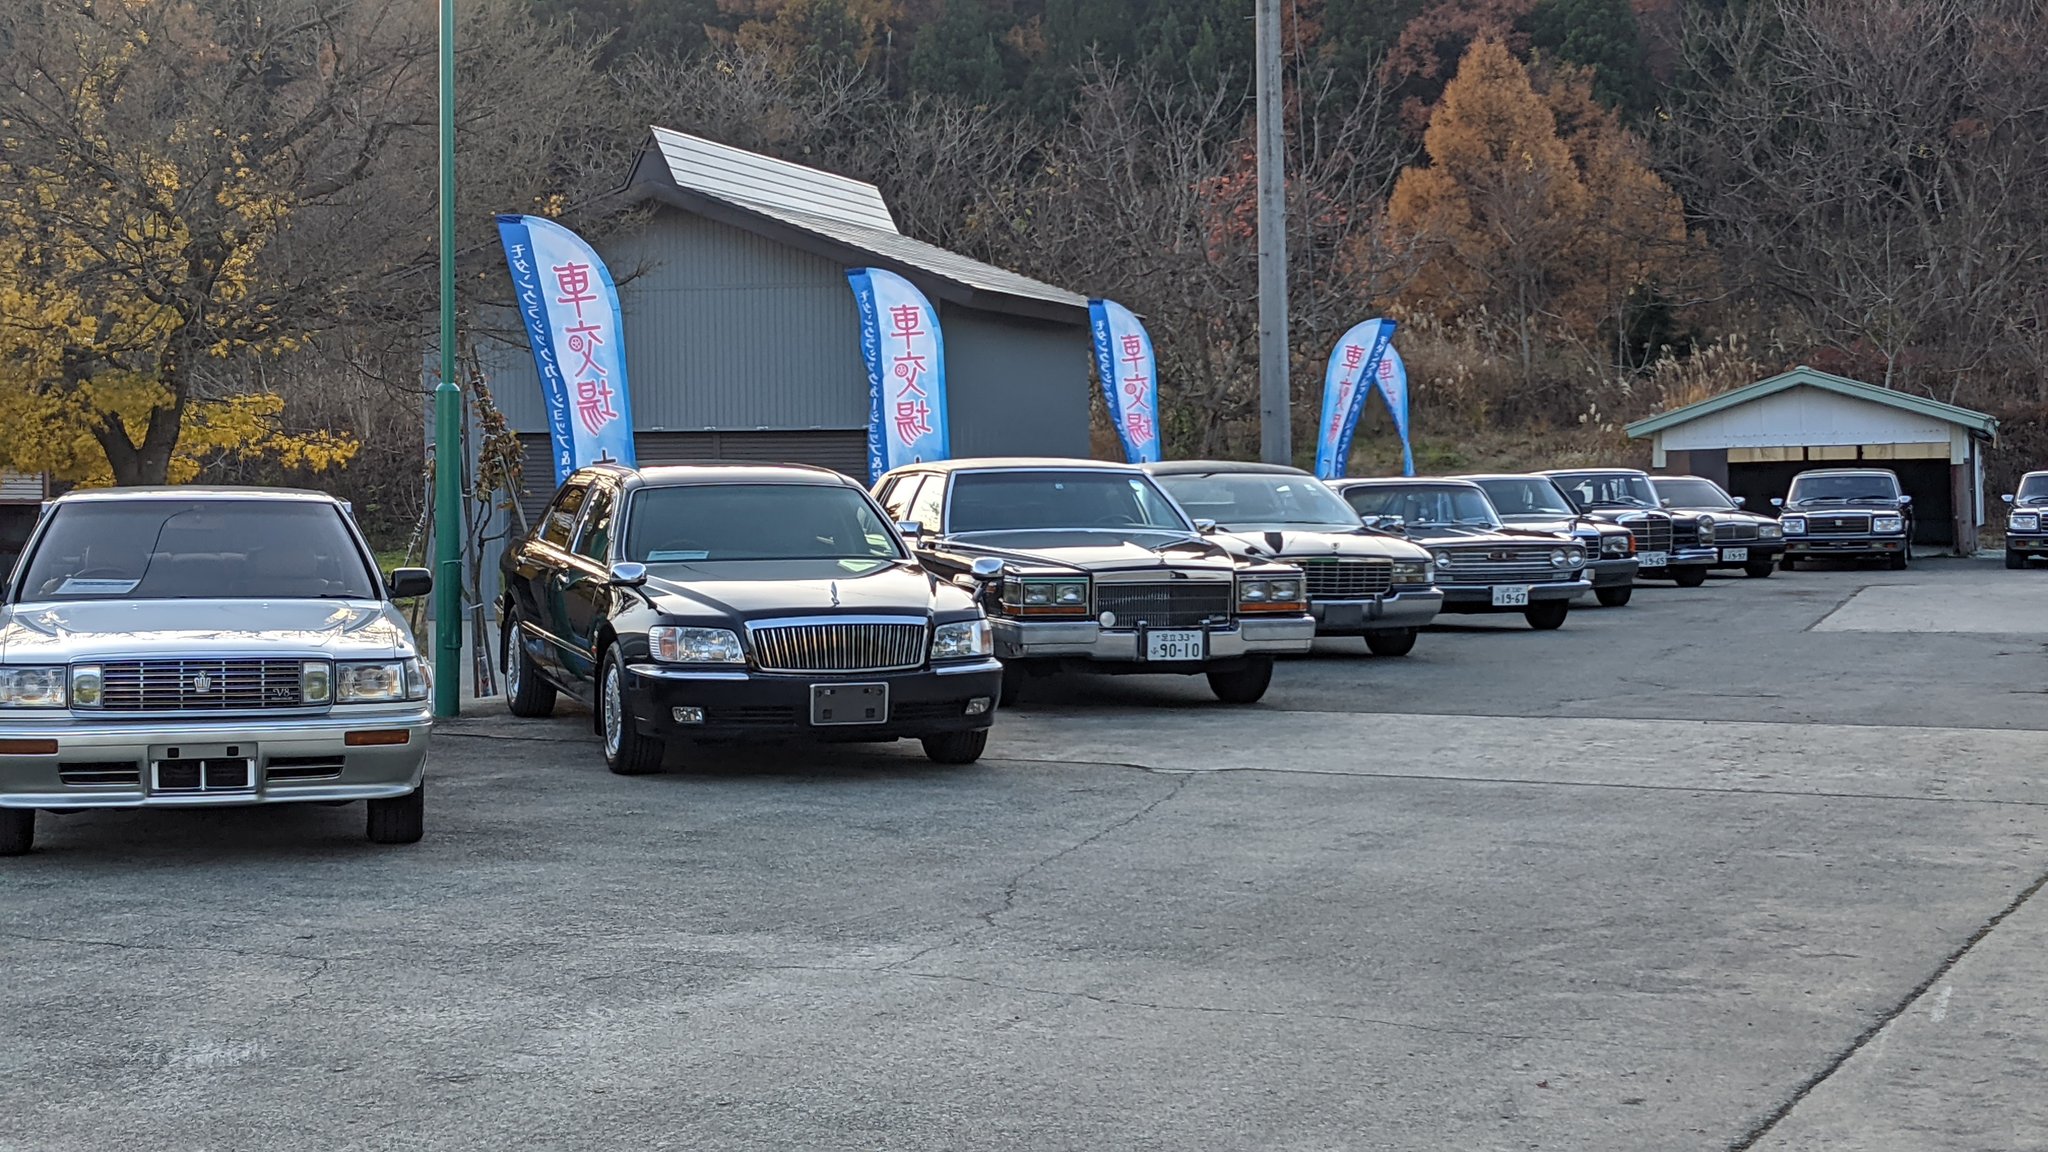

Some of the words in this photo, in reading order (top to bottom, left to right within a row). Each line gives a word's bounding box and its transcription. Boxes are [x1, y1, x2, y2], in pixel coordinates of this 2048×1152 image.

[1501, 593, 1526, 604] 19-67
[1160, 643, 1200, 658] 90-10
[272, 688, 290, 697] V8
